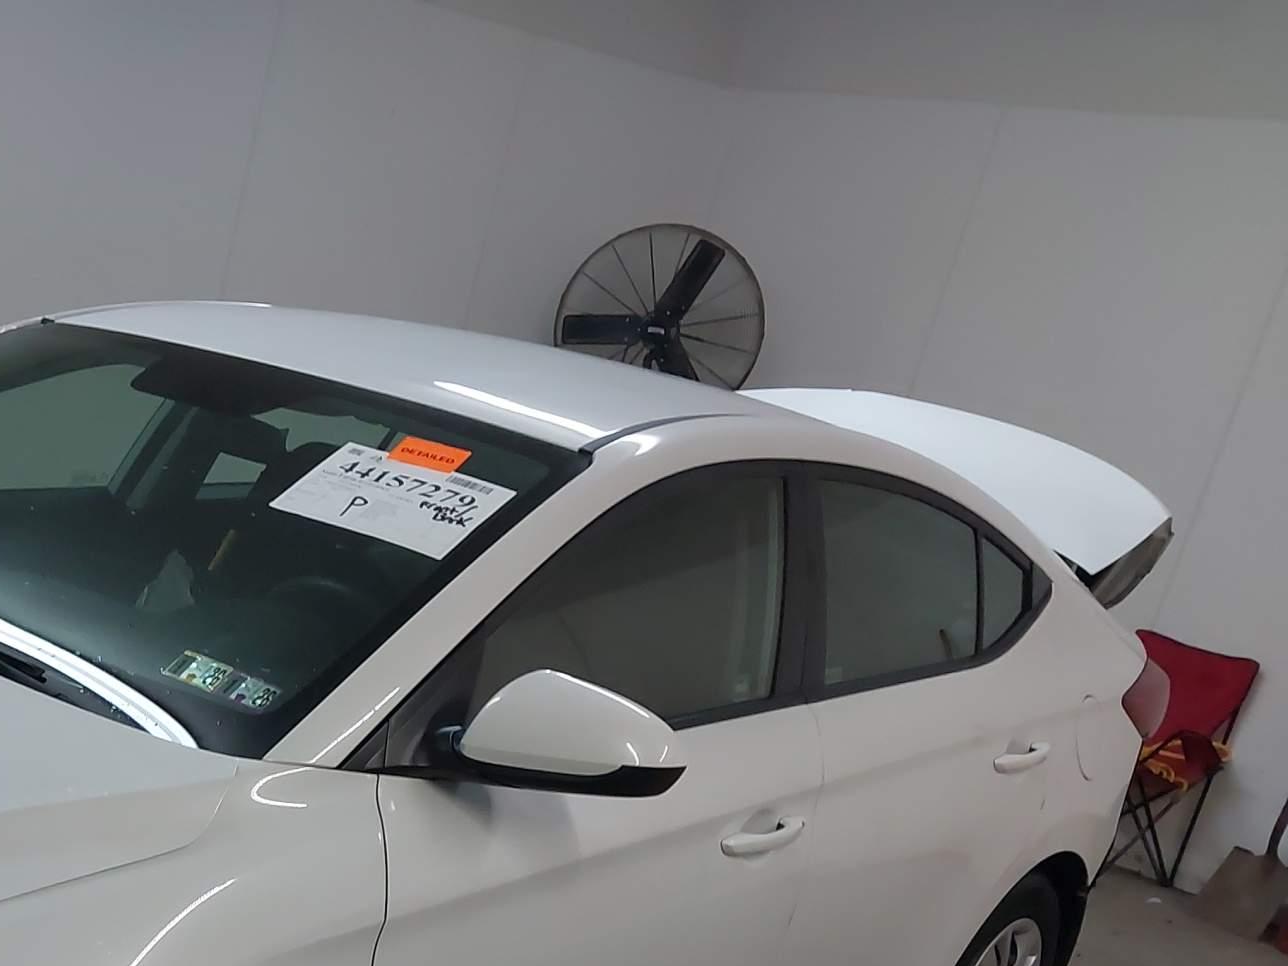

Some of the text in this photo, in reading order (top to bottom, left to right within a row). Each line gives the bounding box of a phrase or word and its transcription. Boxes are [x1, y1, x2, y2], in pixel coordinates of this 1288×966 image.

[400, 446, 455, 465] DETAILED
[339, 461, 477, 508] 44157279
[339, 496, 369, 517] P
